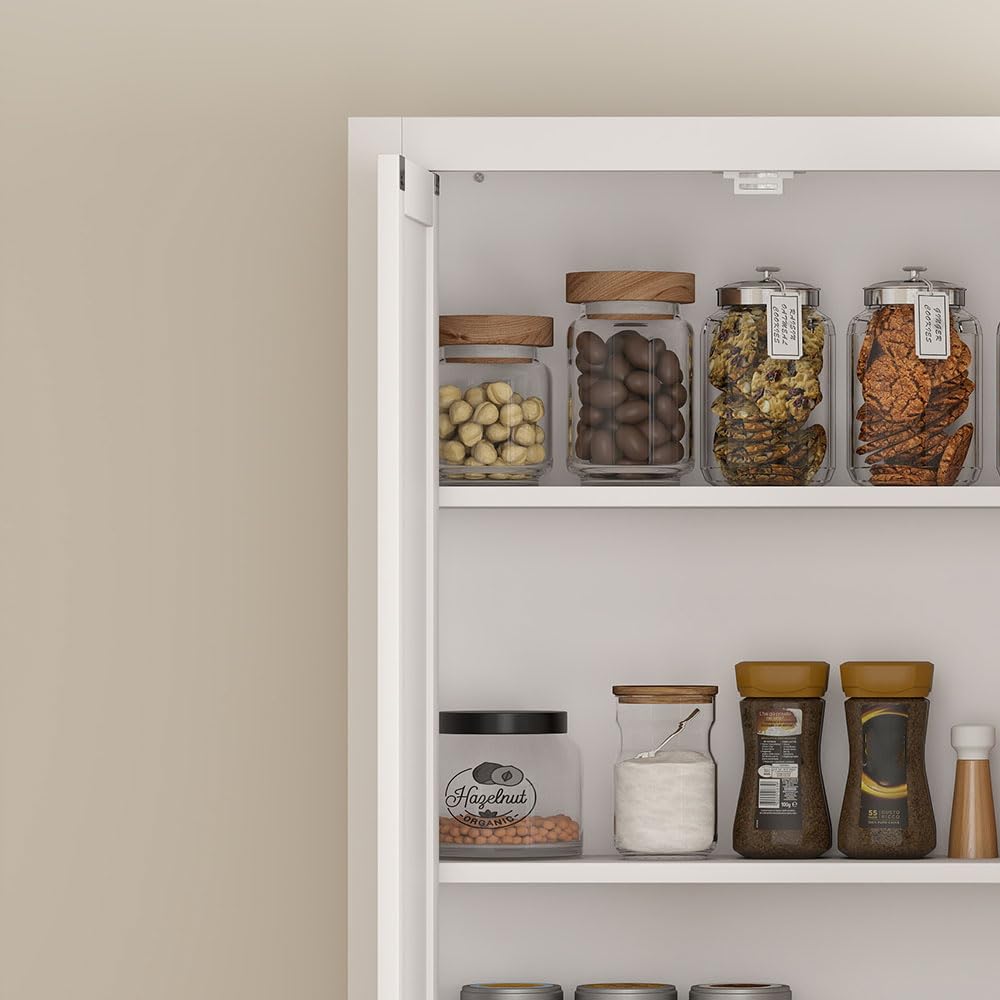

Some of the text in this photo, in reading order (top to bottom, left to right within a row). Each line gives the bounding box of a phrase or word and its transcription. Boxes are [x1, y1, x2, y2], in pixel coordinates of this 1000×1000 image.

[924, 304, 932, 344] COOKIES
[933, 307, 942, 342] GINGER
[445, 785, 528, 809] Hazelnut
[463, 814, 514, 826] ORGANIC
